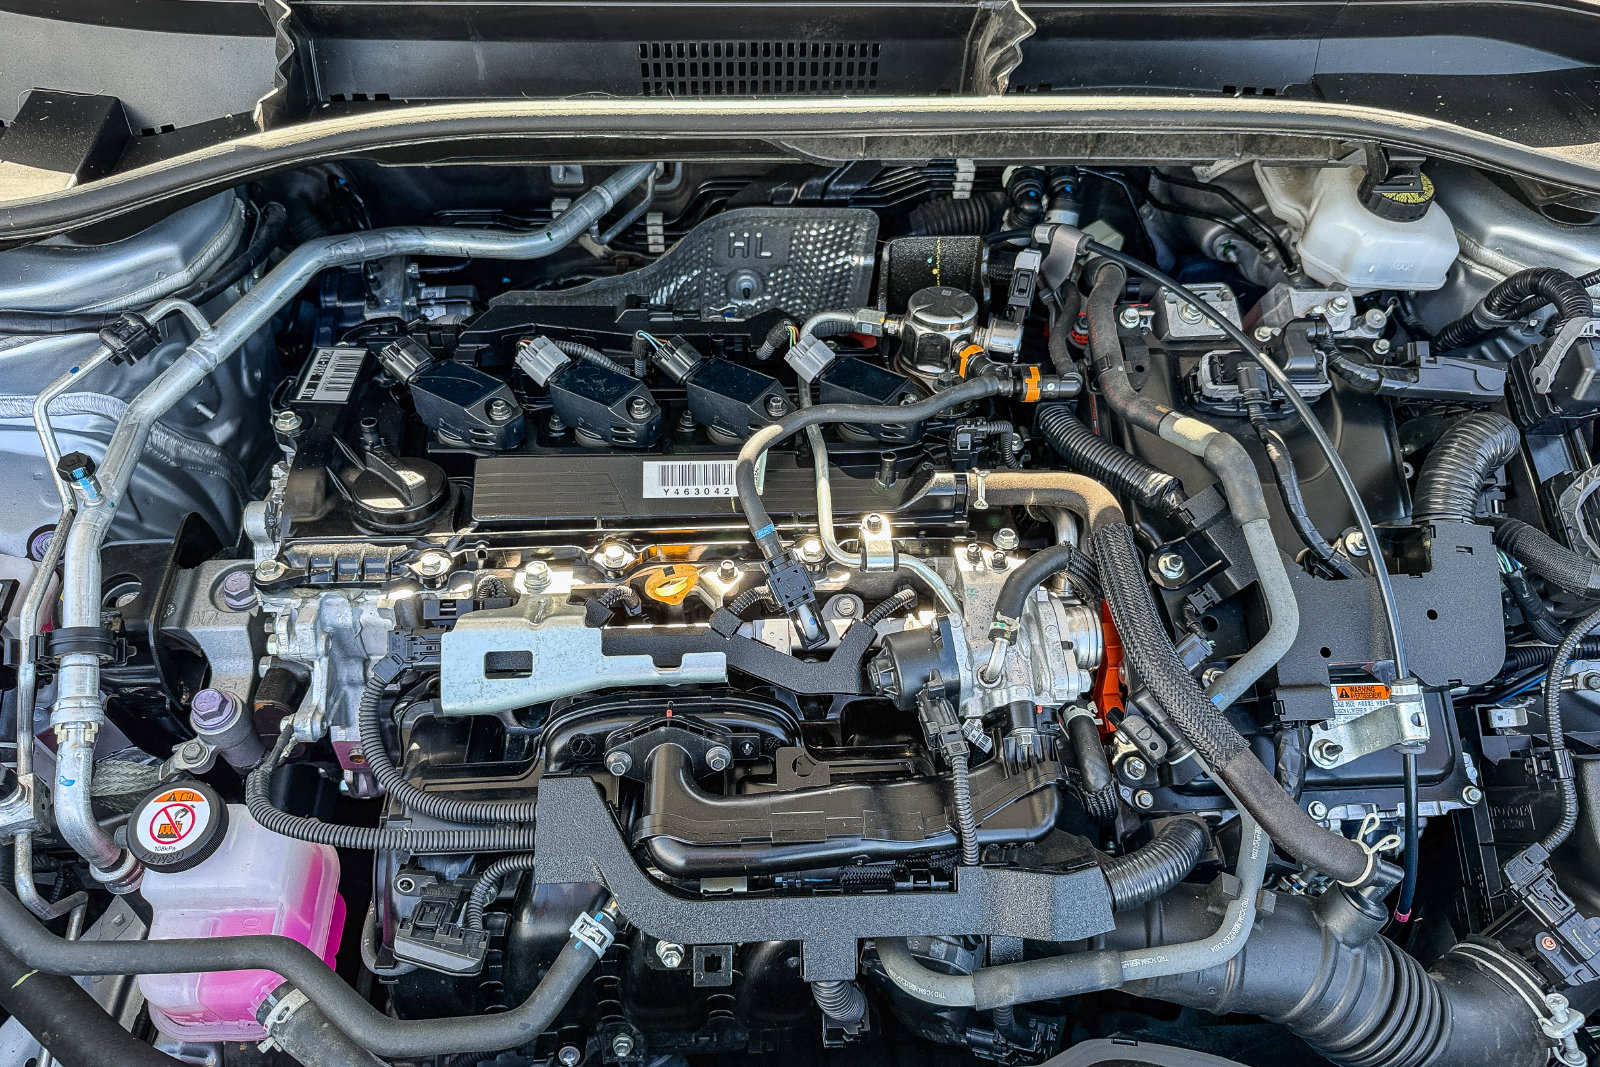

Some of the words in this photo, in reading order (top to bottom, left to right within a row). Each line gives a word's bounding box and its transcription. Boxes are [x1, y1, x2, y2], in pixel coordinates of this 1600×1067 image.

[728, 231, 773, 259] HL
[663, 487, 731, 496] Y463042
[1493, 804, 1531, 817] TOYOTA
[140, 850, 185, 864] DENSO
